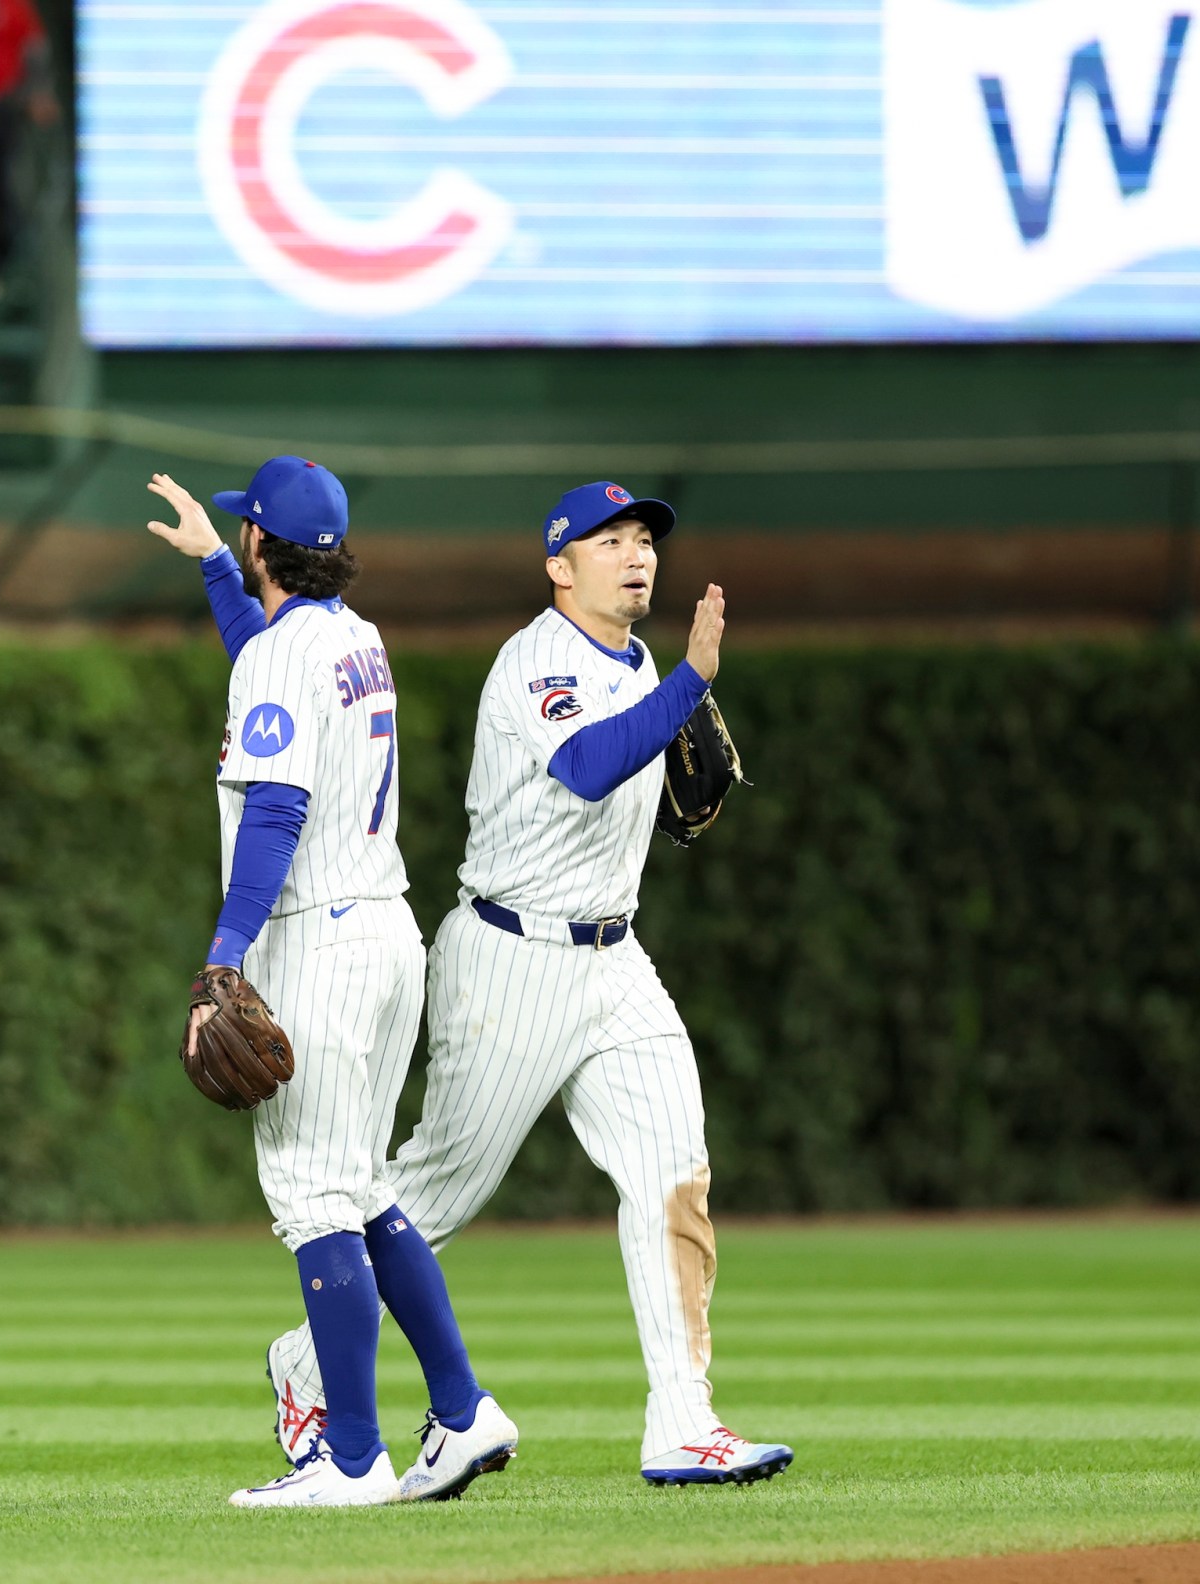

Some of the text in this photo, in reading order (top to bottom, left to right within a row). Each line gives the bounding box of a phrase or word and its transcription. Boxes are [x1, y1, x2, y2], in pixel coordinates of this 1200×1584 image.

[197, 0, 517, 314] C
[977, 12, 1193, 250] W
[605, 485, 629, 504] C
[367, 709, 395, 835] 7
[212, 937, 223, 954] 7
